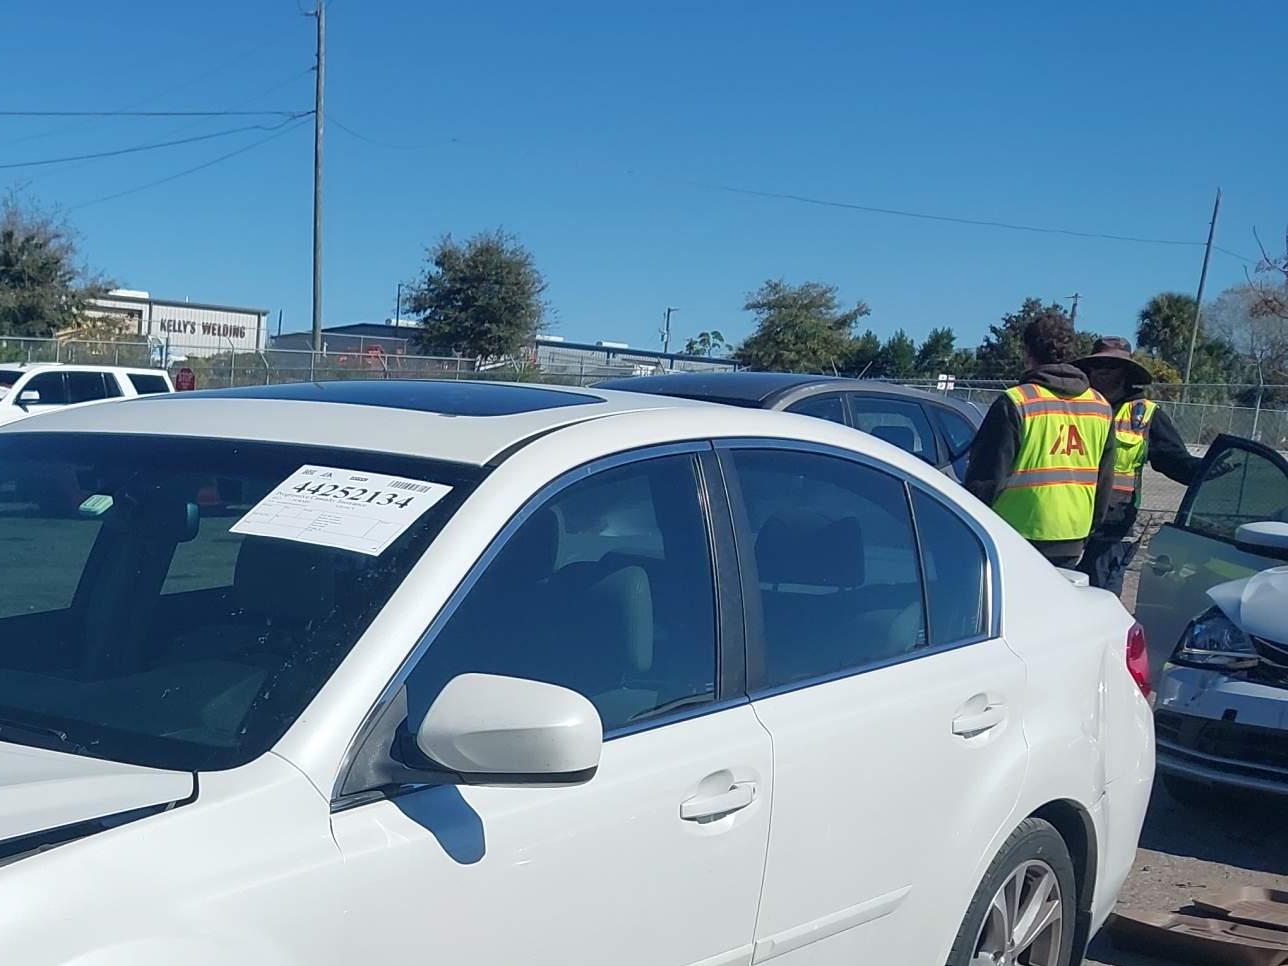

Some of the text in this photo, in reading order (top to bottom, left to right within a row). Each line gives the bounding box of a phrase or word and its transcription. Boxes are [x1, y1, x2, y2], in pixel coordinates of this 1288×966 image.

[160, 318, 246, 339] KELLY'S WELDING
[292, 480, 416, 509] 44252134
